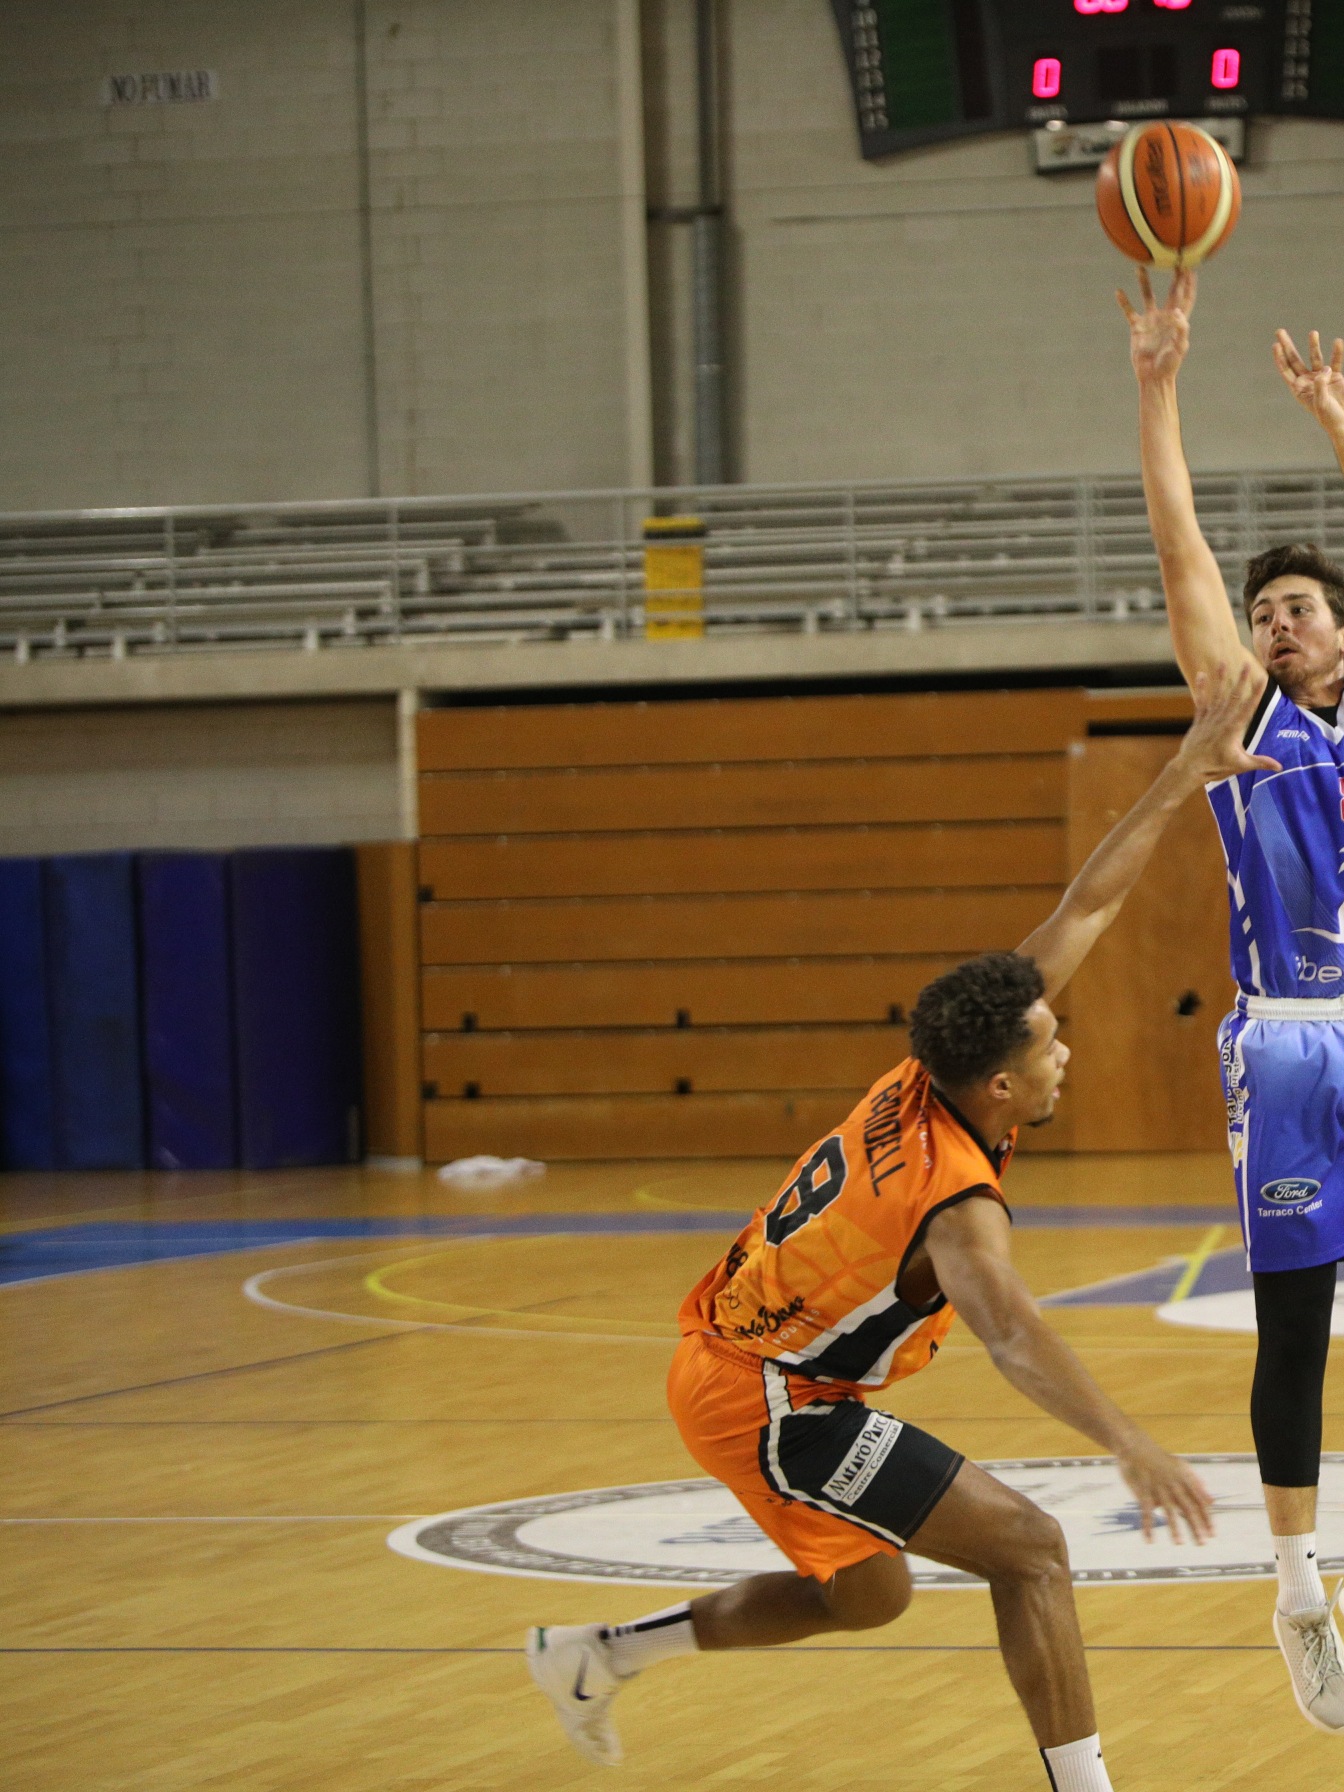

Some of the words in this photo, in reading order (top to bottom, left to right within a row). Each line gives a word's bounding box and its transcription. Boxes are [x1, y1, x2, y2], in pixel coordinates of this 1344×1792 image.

[110, 74, 136, 101] NO
[141, 70, 211, 101] FUMAR
[1032, 57, 1061, 98] 0
[1211, 48, 1240, 89] 0
[764, 1134, 849, 1247] 8
[1258, 1207, 1294, 1218] Tarraco
[1296, 1199, 1323, 1215] Center
[1273, 1183, 1309, 1199] Ford
[847, 1472, 873, 1501] Centre
[870, 1424, 900, 1470] Comercial
